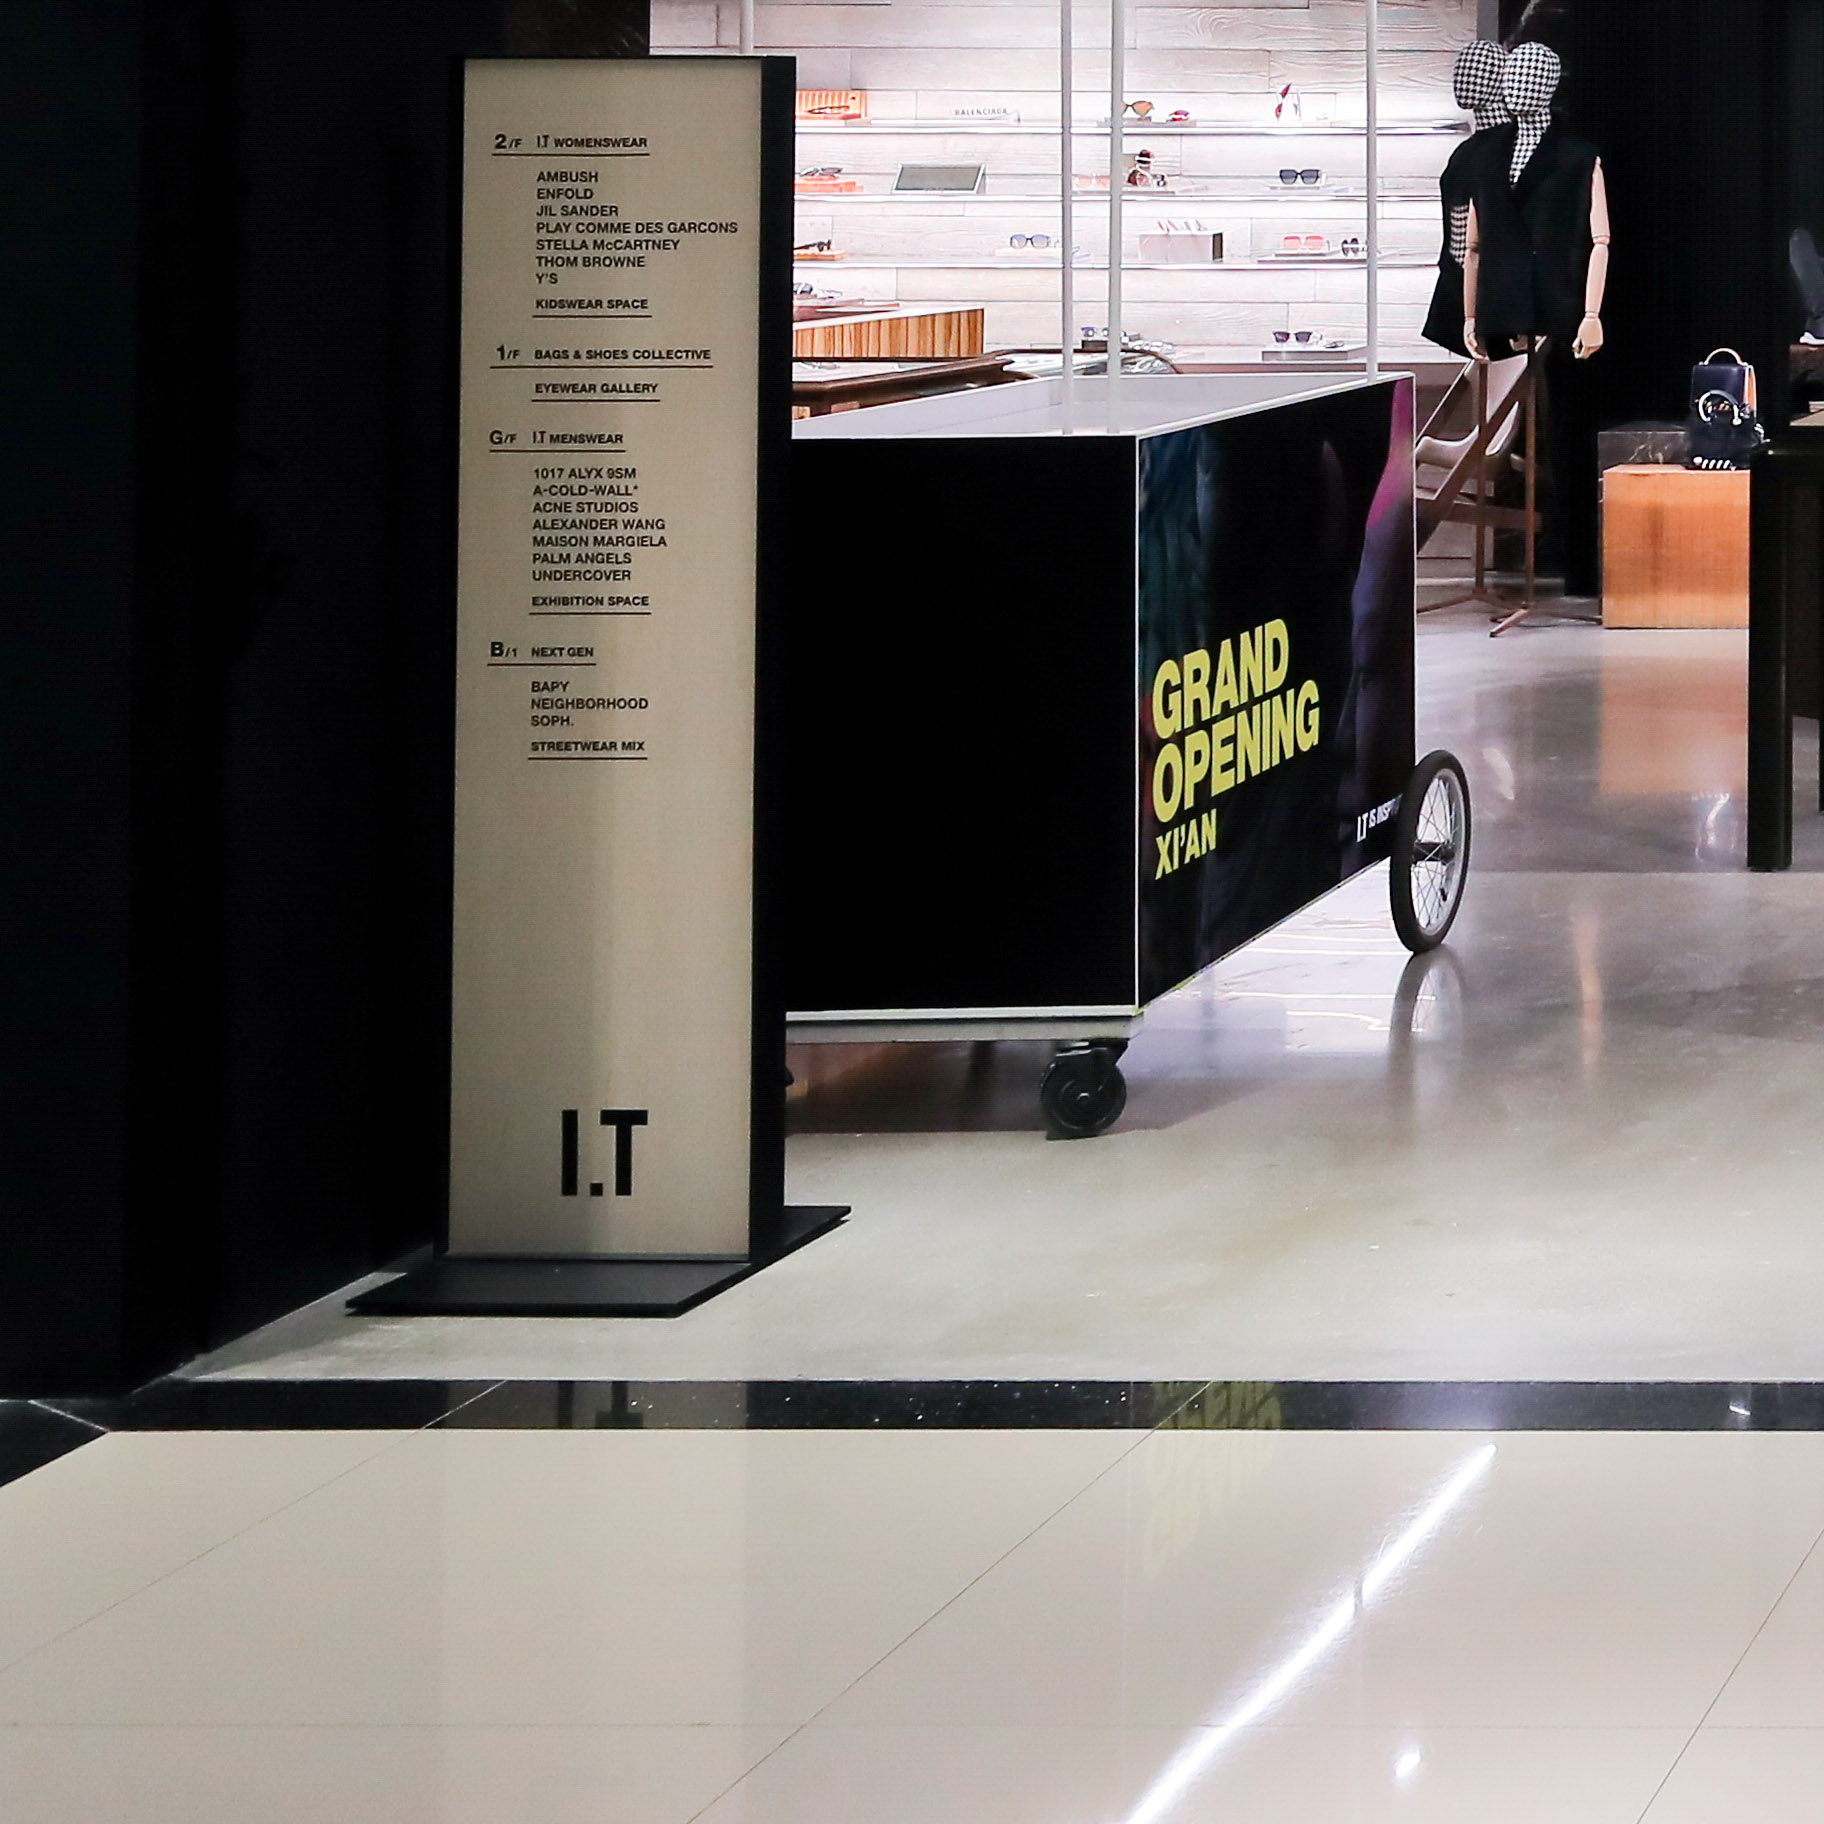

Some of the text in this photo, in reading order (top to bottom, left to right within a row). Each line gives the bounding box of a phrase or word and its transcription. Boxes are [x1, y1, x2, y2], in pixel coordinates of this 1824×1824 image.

[536, 134, 550, 149] I.T
[553, 137, 648, 149] WOMENSWEAR
[536, 170, 599, 183] AMBUSH
[536, 187, 595, 200] ENFOLD
[535, 204, 619, 217] JIL SANDER
[536, 221, 738, 234] PLAY COMME DES GARCONS
[535, 238, 681, 251] STELLA McCARTNEY
[535, 255, 646, 268] THOM BROWNE
[535, 272, 559, 285] Y'S
[535, 298, 649, 310] KIDSWEAR SPACE
[534, 349, 570, 361] BAGS
[572, 349, 582, 360] &
[585, 349, 629, 360] SHOES
[632, 349, 712, 360] COLLECTIVE
[534, 382, 659, 394] EYEWEAR GALLERY
[532, 430, 547, 444] I.T
[548, 432, 624, 445] MENSWEAR
[533, 467, 637, 480] 1017 ALYX 9SM
[532, 501, 639, 514] ACNE STUDIOS
[531, 518, 666, 531] ALEXANDER WANG
[532, 535, 668, 548] MAISON MARGIELA
[532, 551, 632, 566] PALM ANGELS
[531, 569, 632, 582] UNDERCOVER
[531, 595, 650, 607] EXHIBITION SPACE
[530, 646, 566, 658] NEXT
[566, 646, 594, 658] GEN
[1152, 618, 1289, 740] GRAND
[530, 680, 570, 693] BAPY
[530, 696, 649, 711] NEIGHBORHOOD
[530, 714, 574, 727] SOPH.
[530, 740, 645, 752] STREETWEAR MIX
[1152, 679, 1320, 823] OPENING
[562, 1110, 648, 1196] I.T
